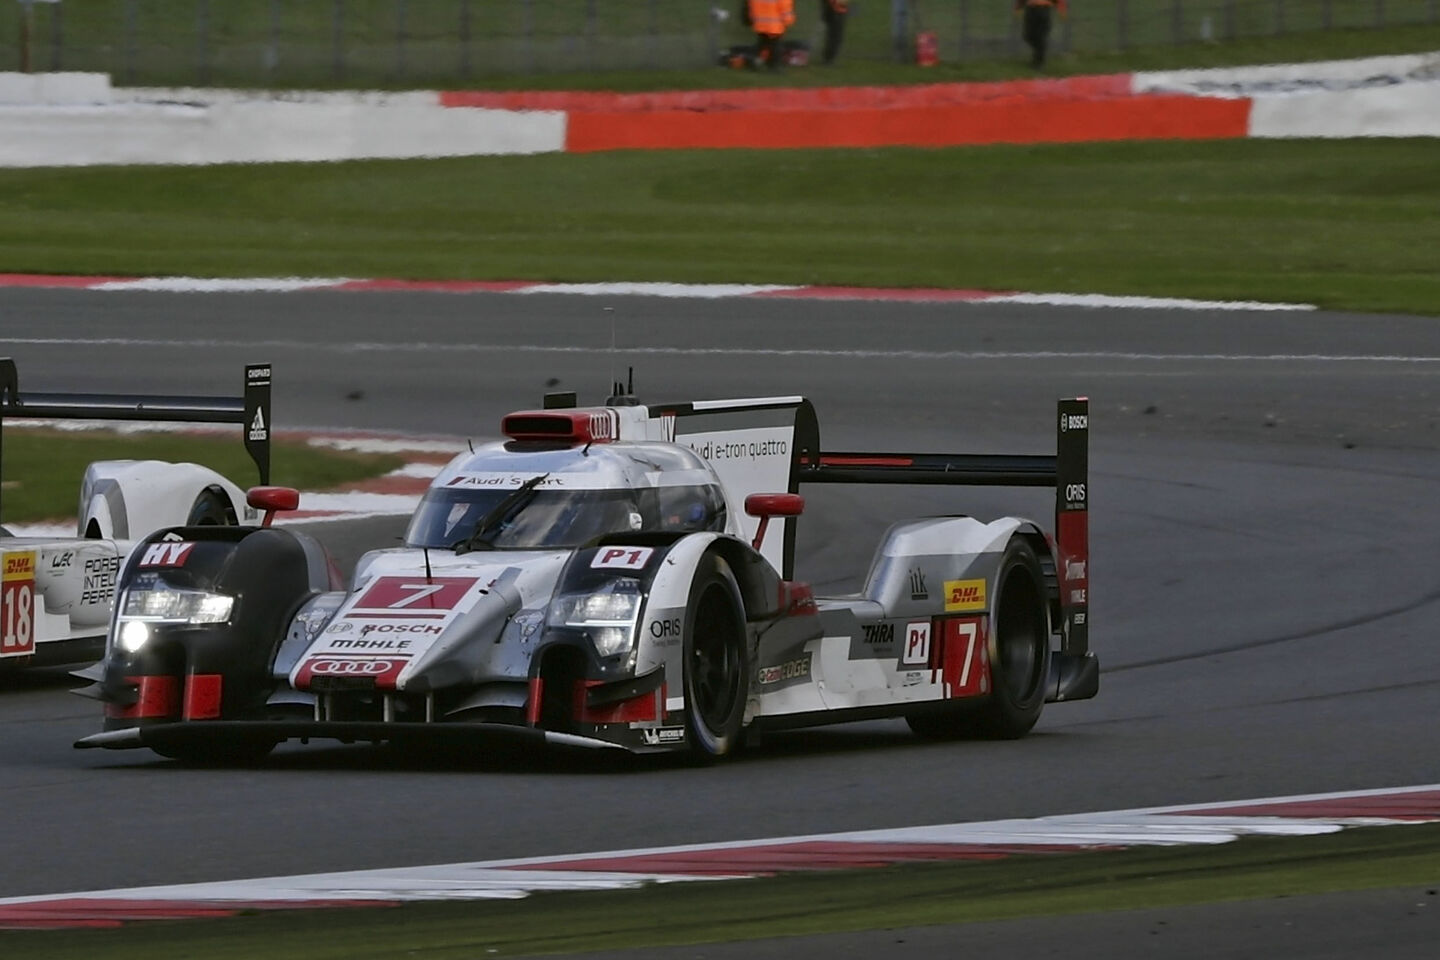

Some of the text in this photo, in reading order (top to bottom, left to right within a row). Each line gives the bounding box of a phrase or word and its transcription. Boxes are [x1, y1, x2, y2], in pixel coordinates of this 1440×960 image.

[1068, 415, 1088, 429] BOSCH
[715, 442, 747, 459] e-tron
[748, 440, 787, 461] quattro
[465, 477, 504, 486] Audi
[1066, 484, 1086, 501] ORIS
[140, 542, 193, 565] HY
[601, 549, 643, 565] P1
[8, 558, 31, 574] DHL
[387, 584, 445, 609] 7
[951, 587, 979, 604] DHL
[3, 585, 32, 648] 18
[361, 623, 443, 635] BOSCH
[650, 618, 681, 638] ORIS
[329, 639, 412, 649] MAHLE
[907, 629, 927, 658] P1
[958, 622, 977, 687] 7
